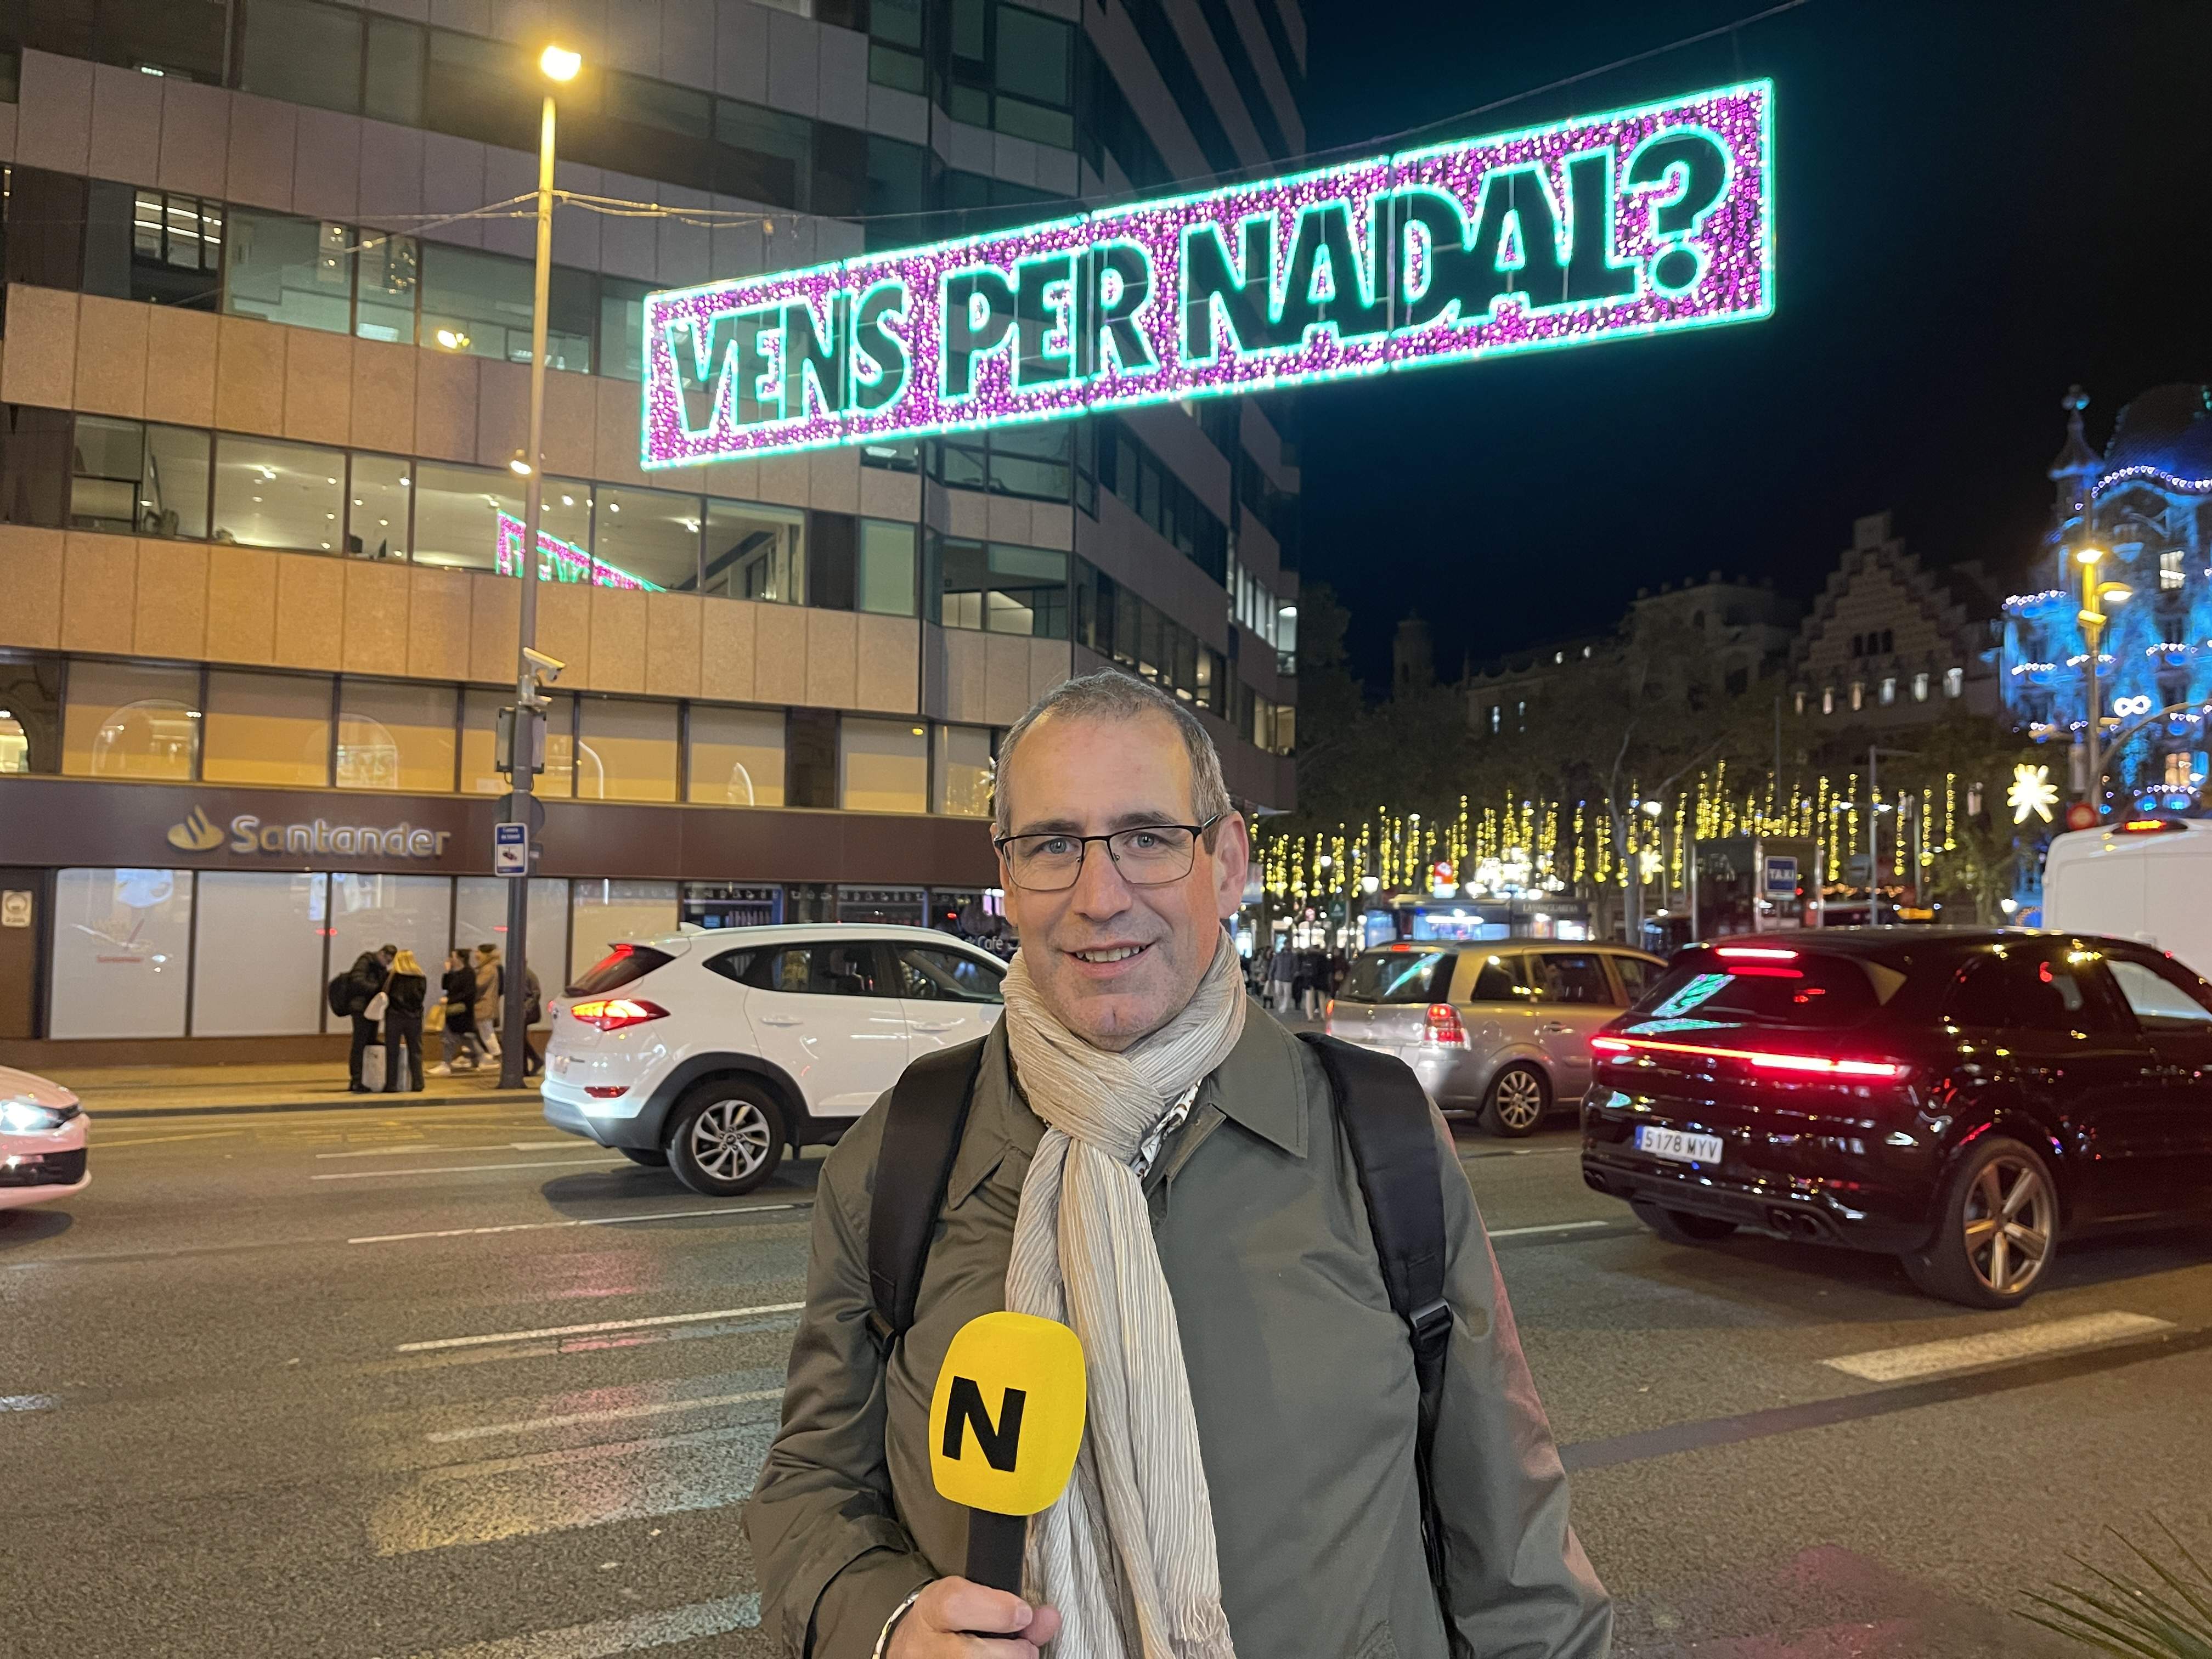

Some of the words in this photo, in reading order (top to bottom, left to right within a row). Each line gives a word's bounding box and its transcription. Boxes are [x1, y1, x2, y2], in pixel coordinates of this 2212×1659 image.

[663, 278, 912, 439] VENS
[939, 237, 1160, 404] PER
[1180, 122, 1735, 369] NADAL?
[232, 814, 451, 857] Santander
[1768, 868, 1794, 879] TAXI
[1645, 1130, 1682, 1153] 5178
[1687, 1137, 1718, 1159] MYV
[943, 1375, 1026, 1472] N
